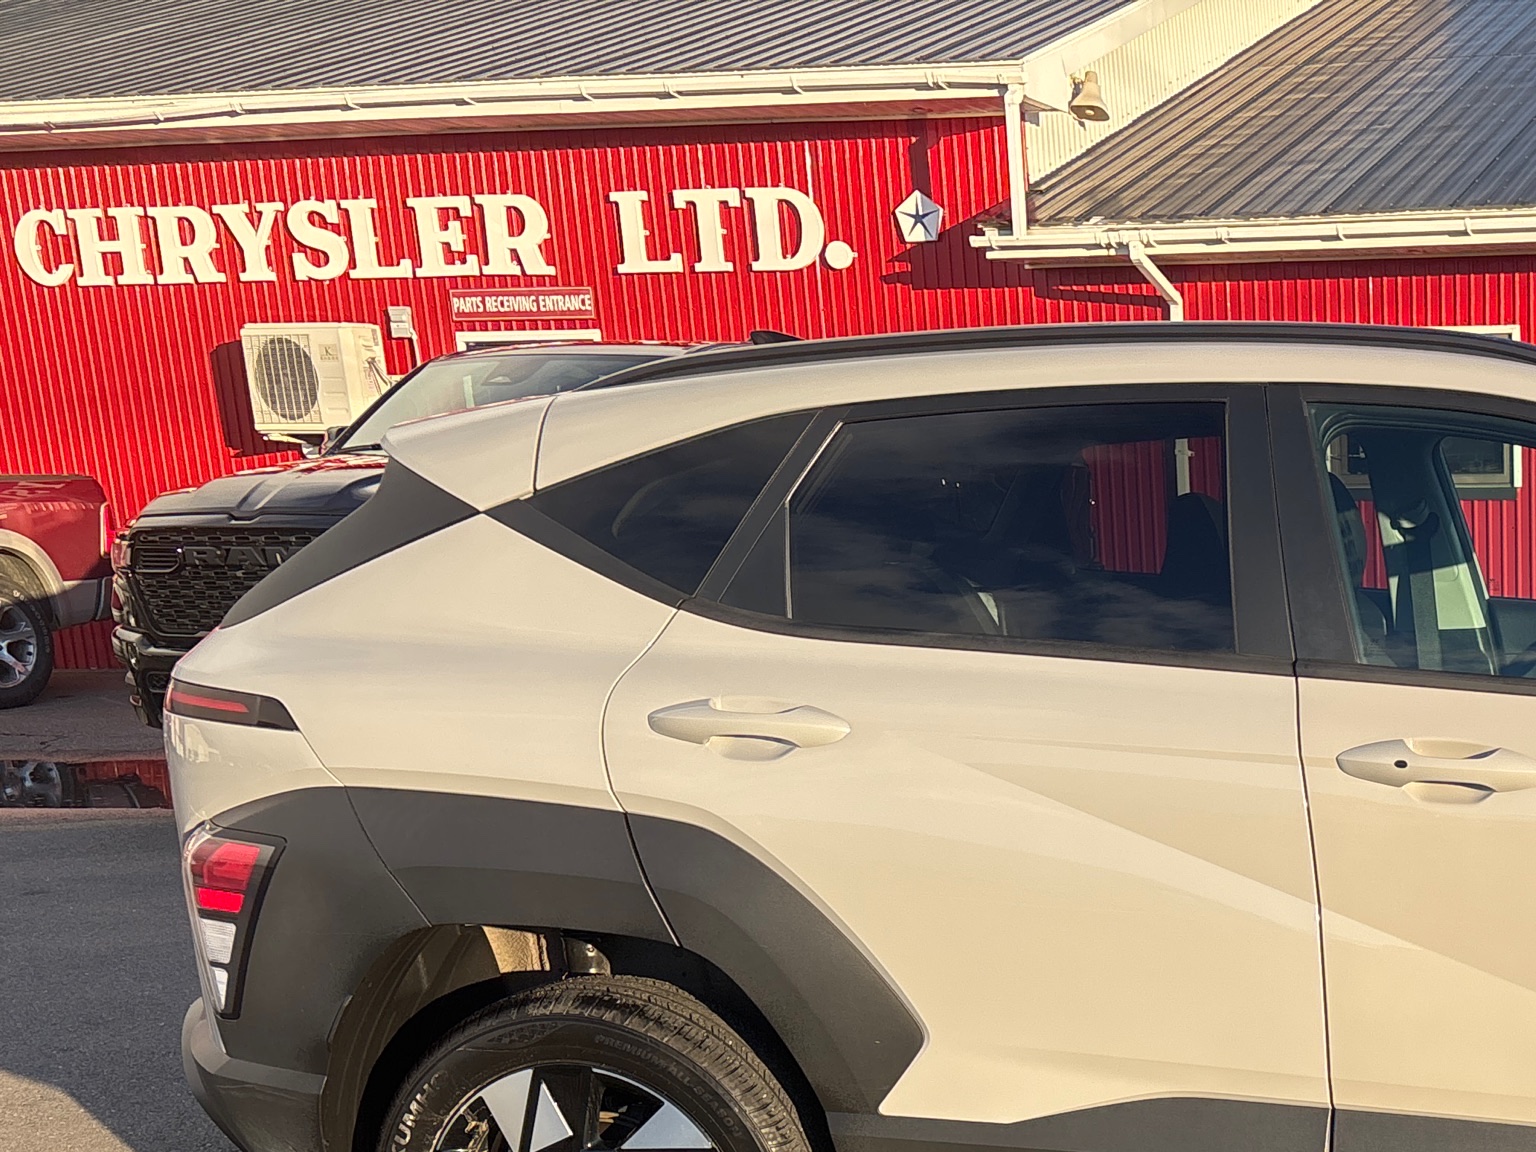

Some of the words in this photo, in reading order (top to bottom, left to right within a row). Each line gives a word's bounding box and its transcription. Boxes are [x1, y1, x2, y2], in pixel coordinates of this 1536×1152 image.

[14, 193, 557, 288] CHRYSLER
[609, 186, 854, 274] LTD.
[453, 296, 484, 313] PARTS
[485, 295, 538, 313] RECEIVING
[539, 294, 592, 311] ENTRANCE
